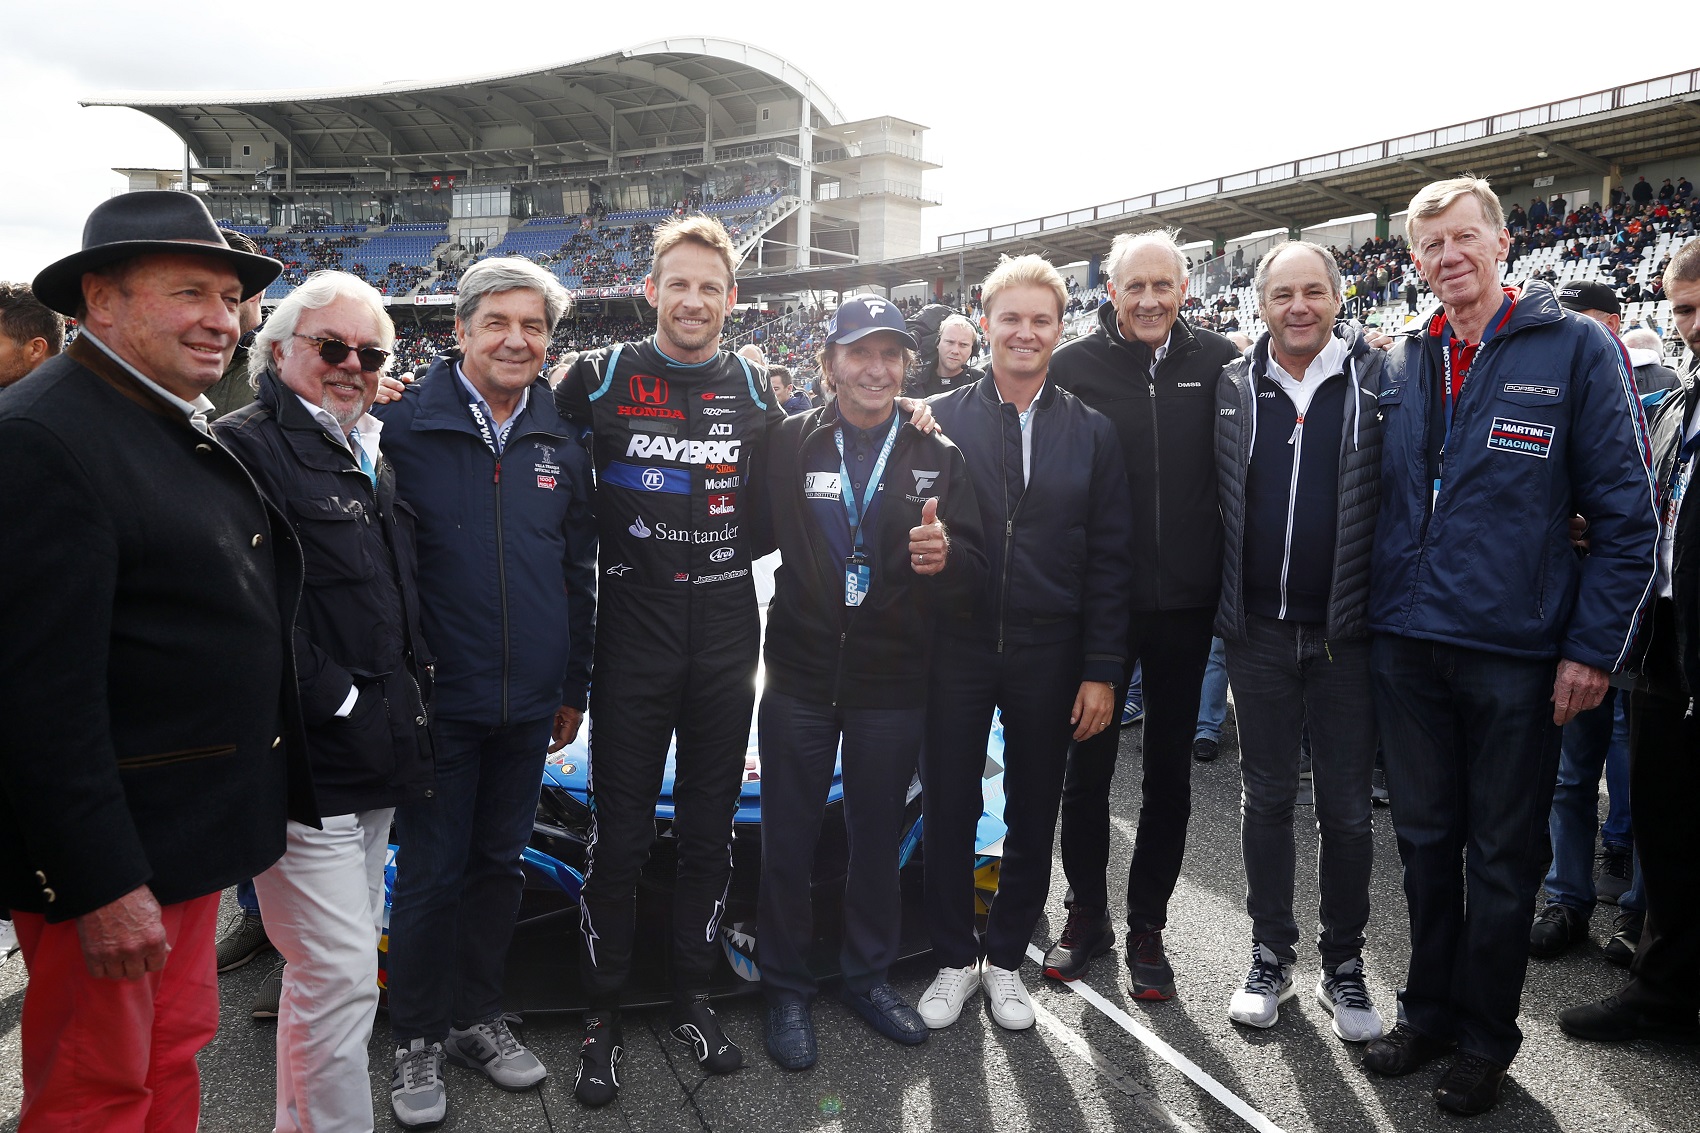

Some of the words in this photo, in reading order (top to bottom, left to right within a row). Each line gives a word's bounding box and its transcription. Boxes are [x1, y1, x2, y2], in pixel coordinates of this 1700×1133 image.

[1443, 345, 1452, 395] DTM.COM
[1258, 391, 1276, 399] DTM
[1506, 385, 1557, 395] PORSCHE
[617, 405, 686, 420] HONDA
[1502, 423, 1544, 437] MARTINI
[626, 433, 742, 465] RAYBRIG
[1498, 438, 1540, 452] RACING
[877, 443, 892, 468] DTM
[645, 472, 661, 486] ZF
[705, 478, 731, 490] Mobil
[655, 522, 739, 545] Santander
